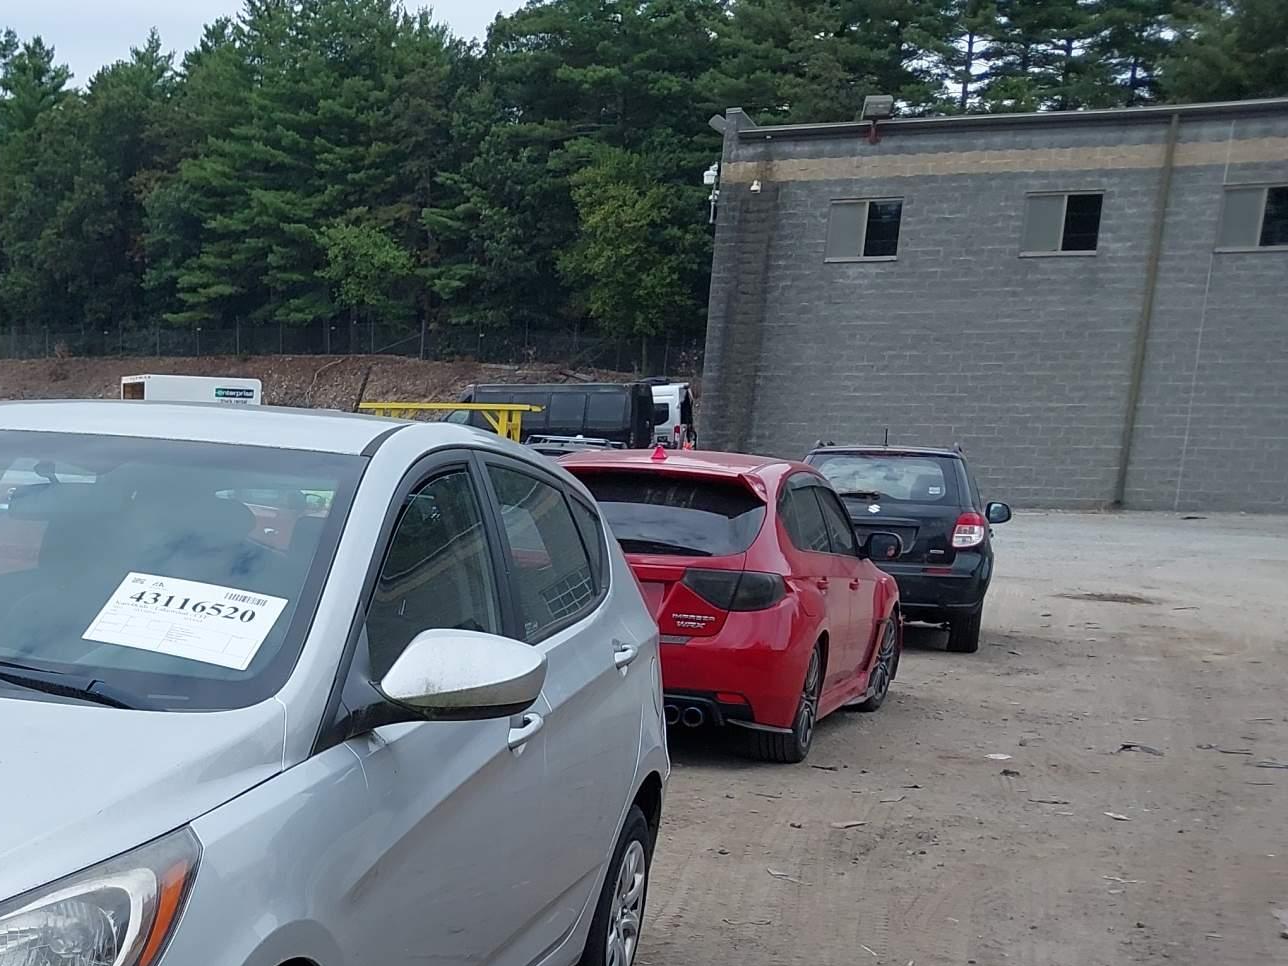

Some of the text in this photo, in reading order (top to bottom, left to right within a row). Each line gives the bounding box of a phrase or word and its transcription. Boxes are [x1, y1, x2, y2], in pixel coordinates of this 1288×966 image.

[216, 389, 253, 398] enterprise
[129, 590, 257, 623] 43116520
[676, 621, 706, 629] WRX
